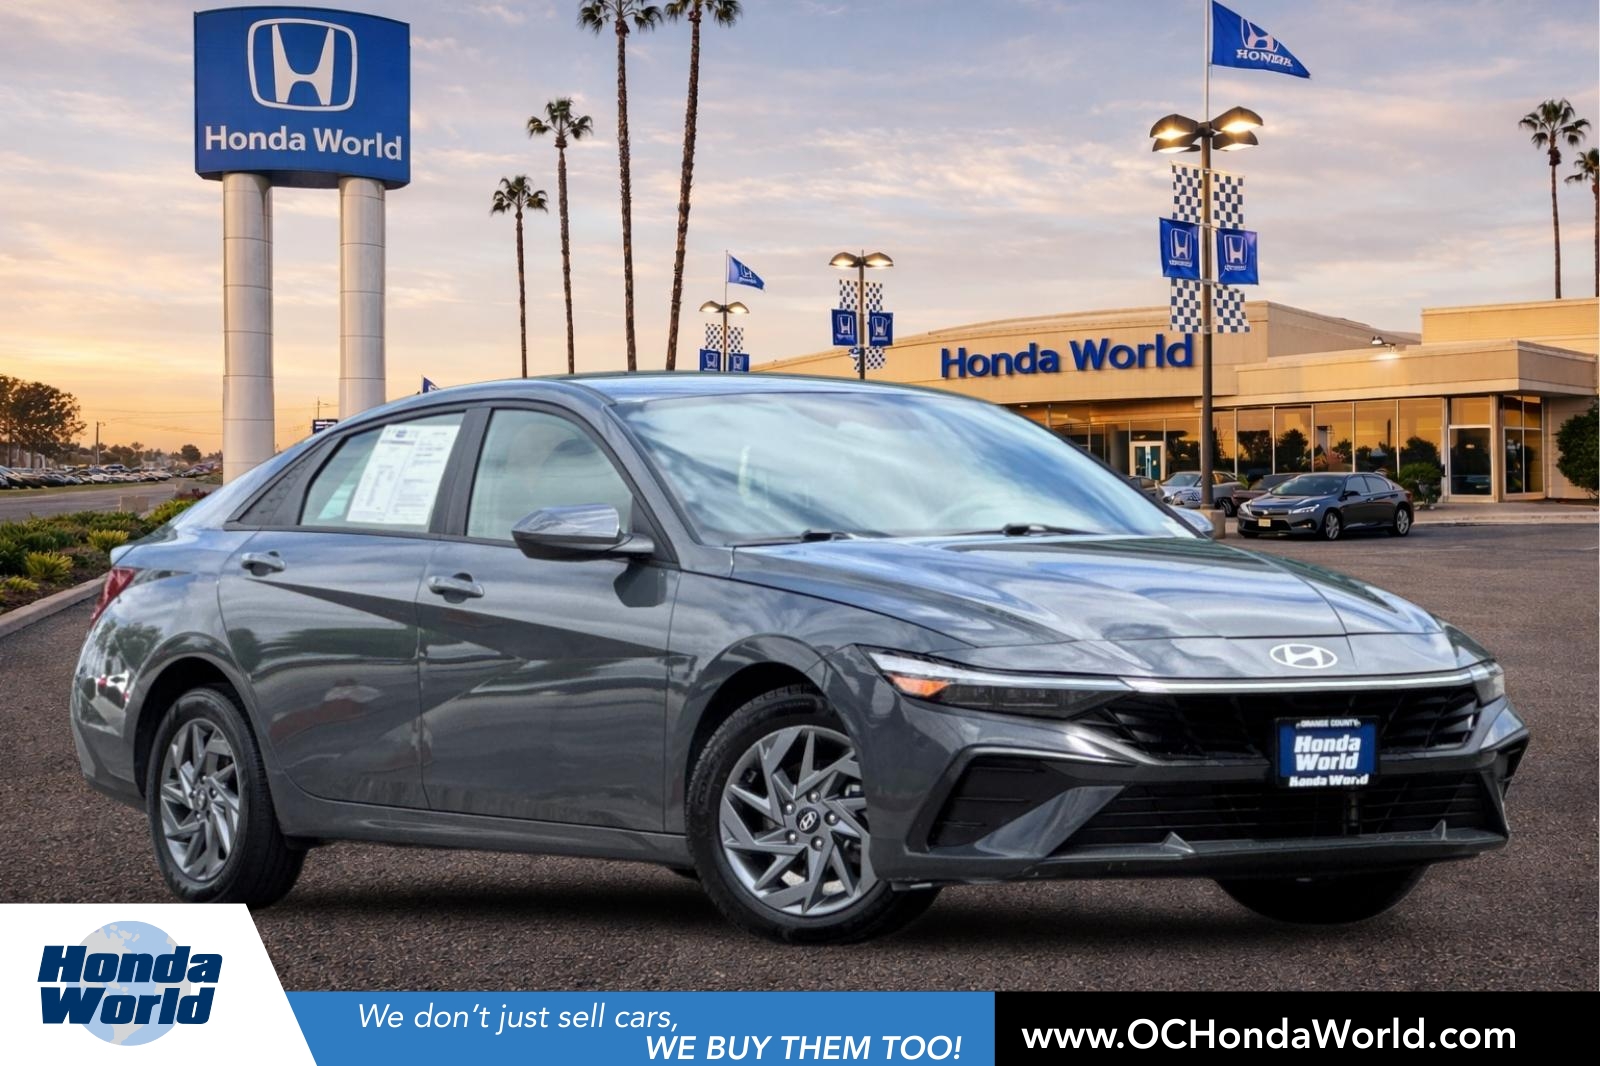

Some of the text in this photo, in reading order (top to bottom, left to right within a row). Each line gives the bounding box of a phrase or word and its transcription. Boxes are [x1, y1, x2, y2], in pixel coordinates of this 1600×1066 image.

[205, 125, 402, 161] Honda World
[941, 333, 1194, 378] Honda World
[1330, 718, 1358, 728] COUNTY
[1294, 734, 1362, 753] Honda
[1295, 753, 1360, 772] World
